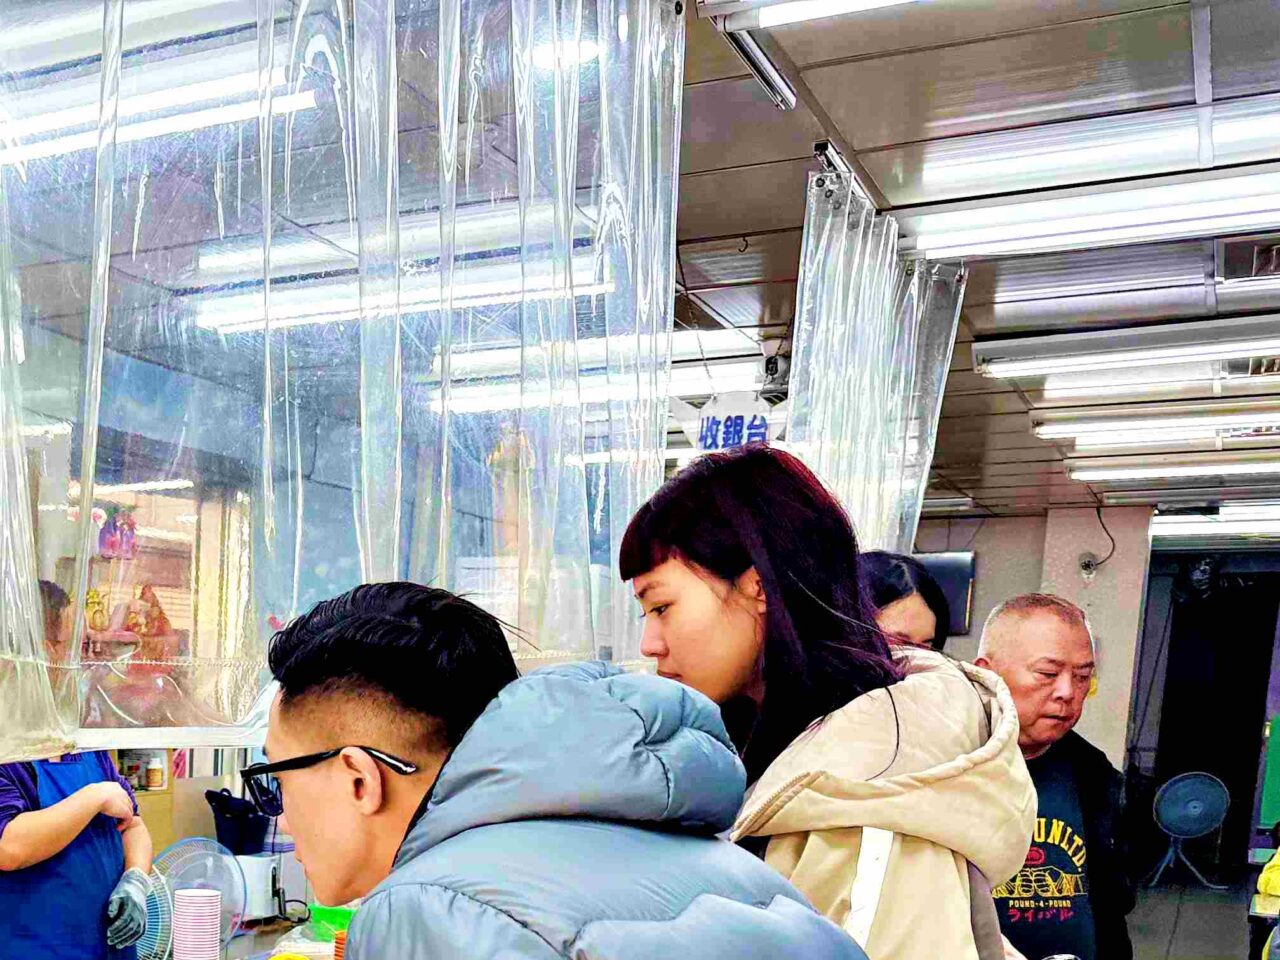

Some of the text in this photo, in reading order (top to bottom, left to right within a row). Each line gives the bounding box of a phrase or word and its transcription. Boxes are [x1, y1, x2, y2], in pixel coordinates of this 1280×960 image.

[699, 414, 768, 450] 收銀台
[1009, 900, 1072, 908] POUND-4-POUND
